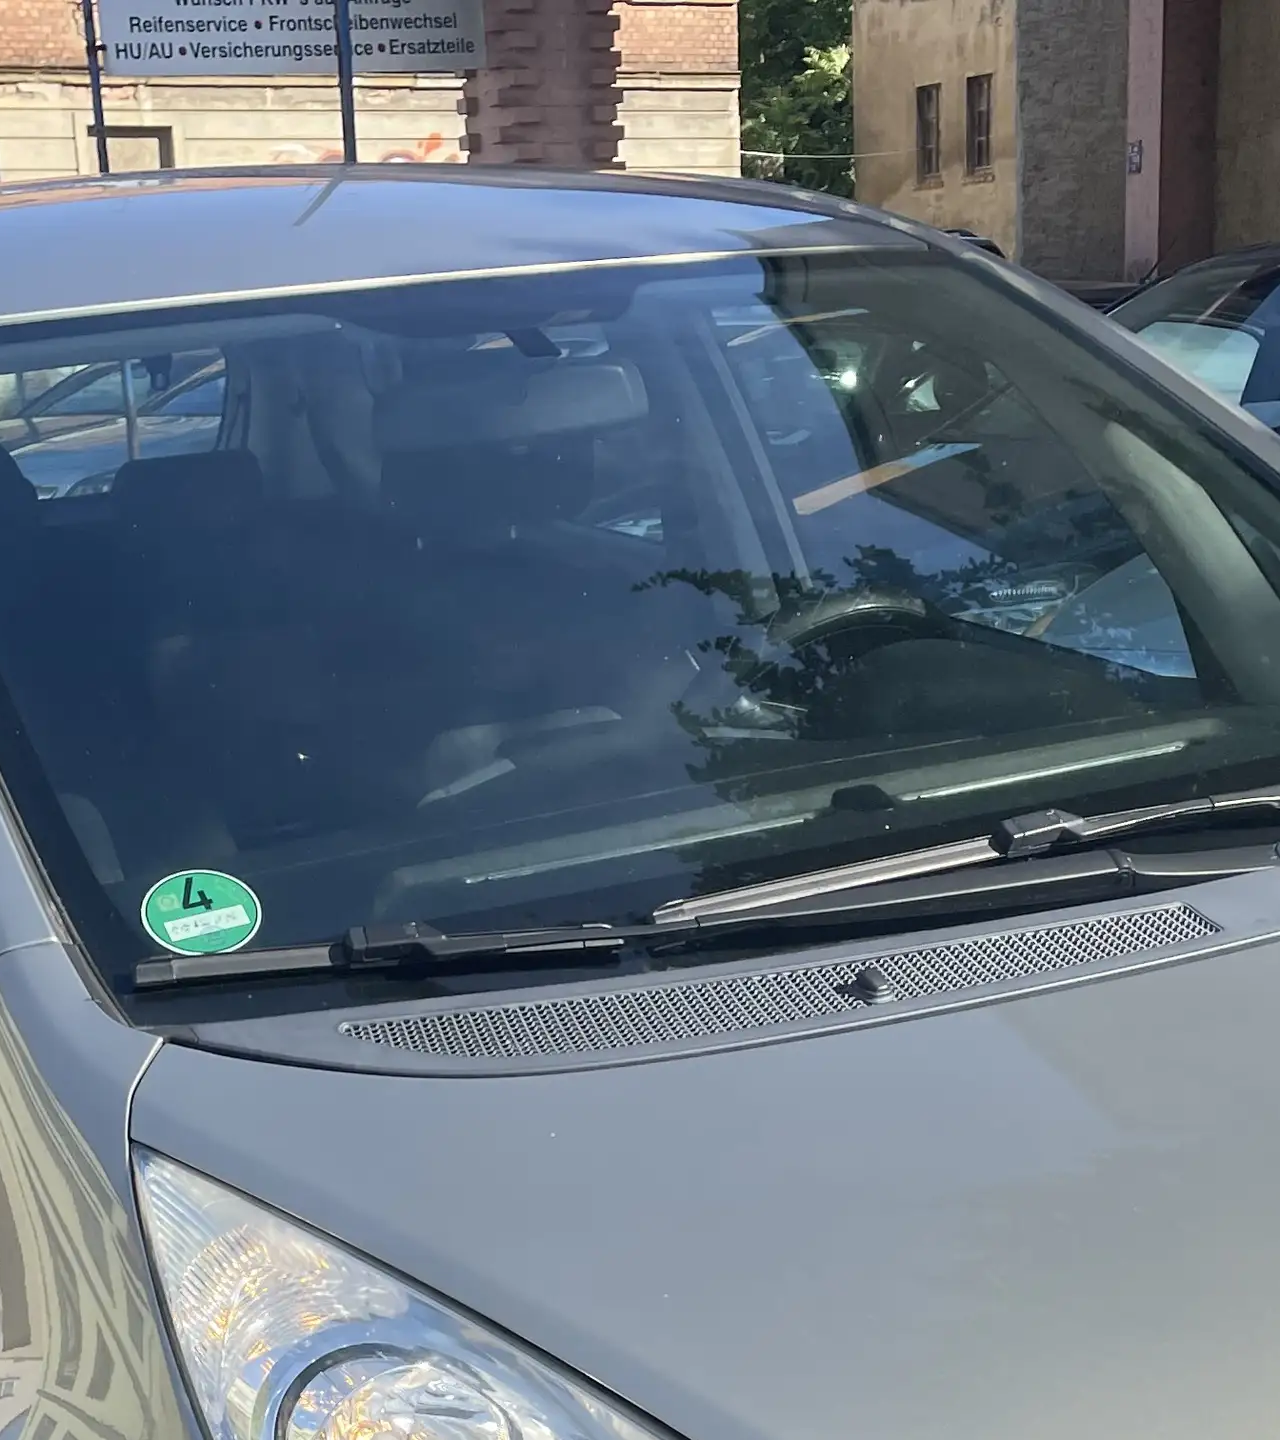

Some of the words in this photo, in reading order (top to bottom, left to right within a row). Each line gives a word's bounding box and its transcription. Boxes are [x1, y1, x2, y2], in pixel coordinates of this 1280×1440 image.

[129, 15, 248, 33] Reifenservice
[269, 12, 458, 32] Frontscibenwechsel
[114, 41, 174, 60] HU/AU
[189, 41, 373, 61] Versicherungsserce
[389, 38, 476, 56] Ersatzteile
[182, 876, 214, 910] 4
